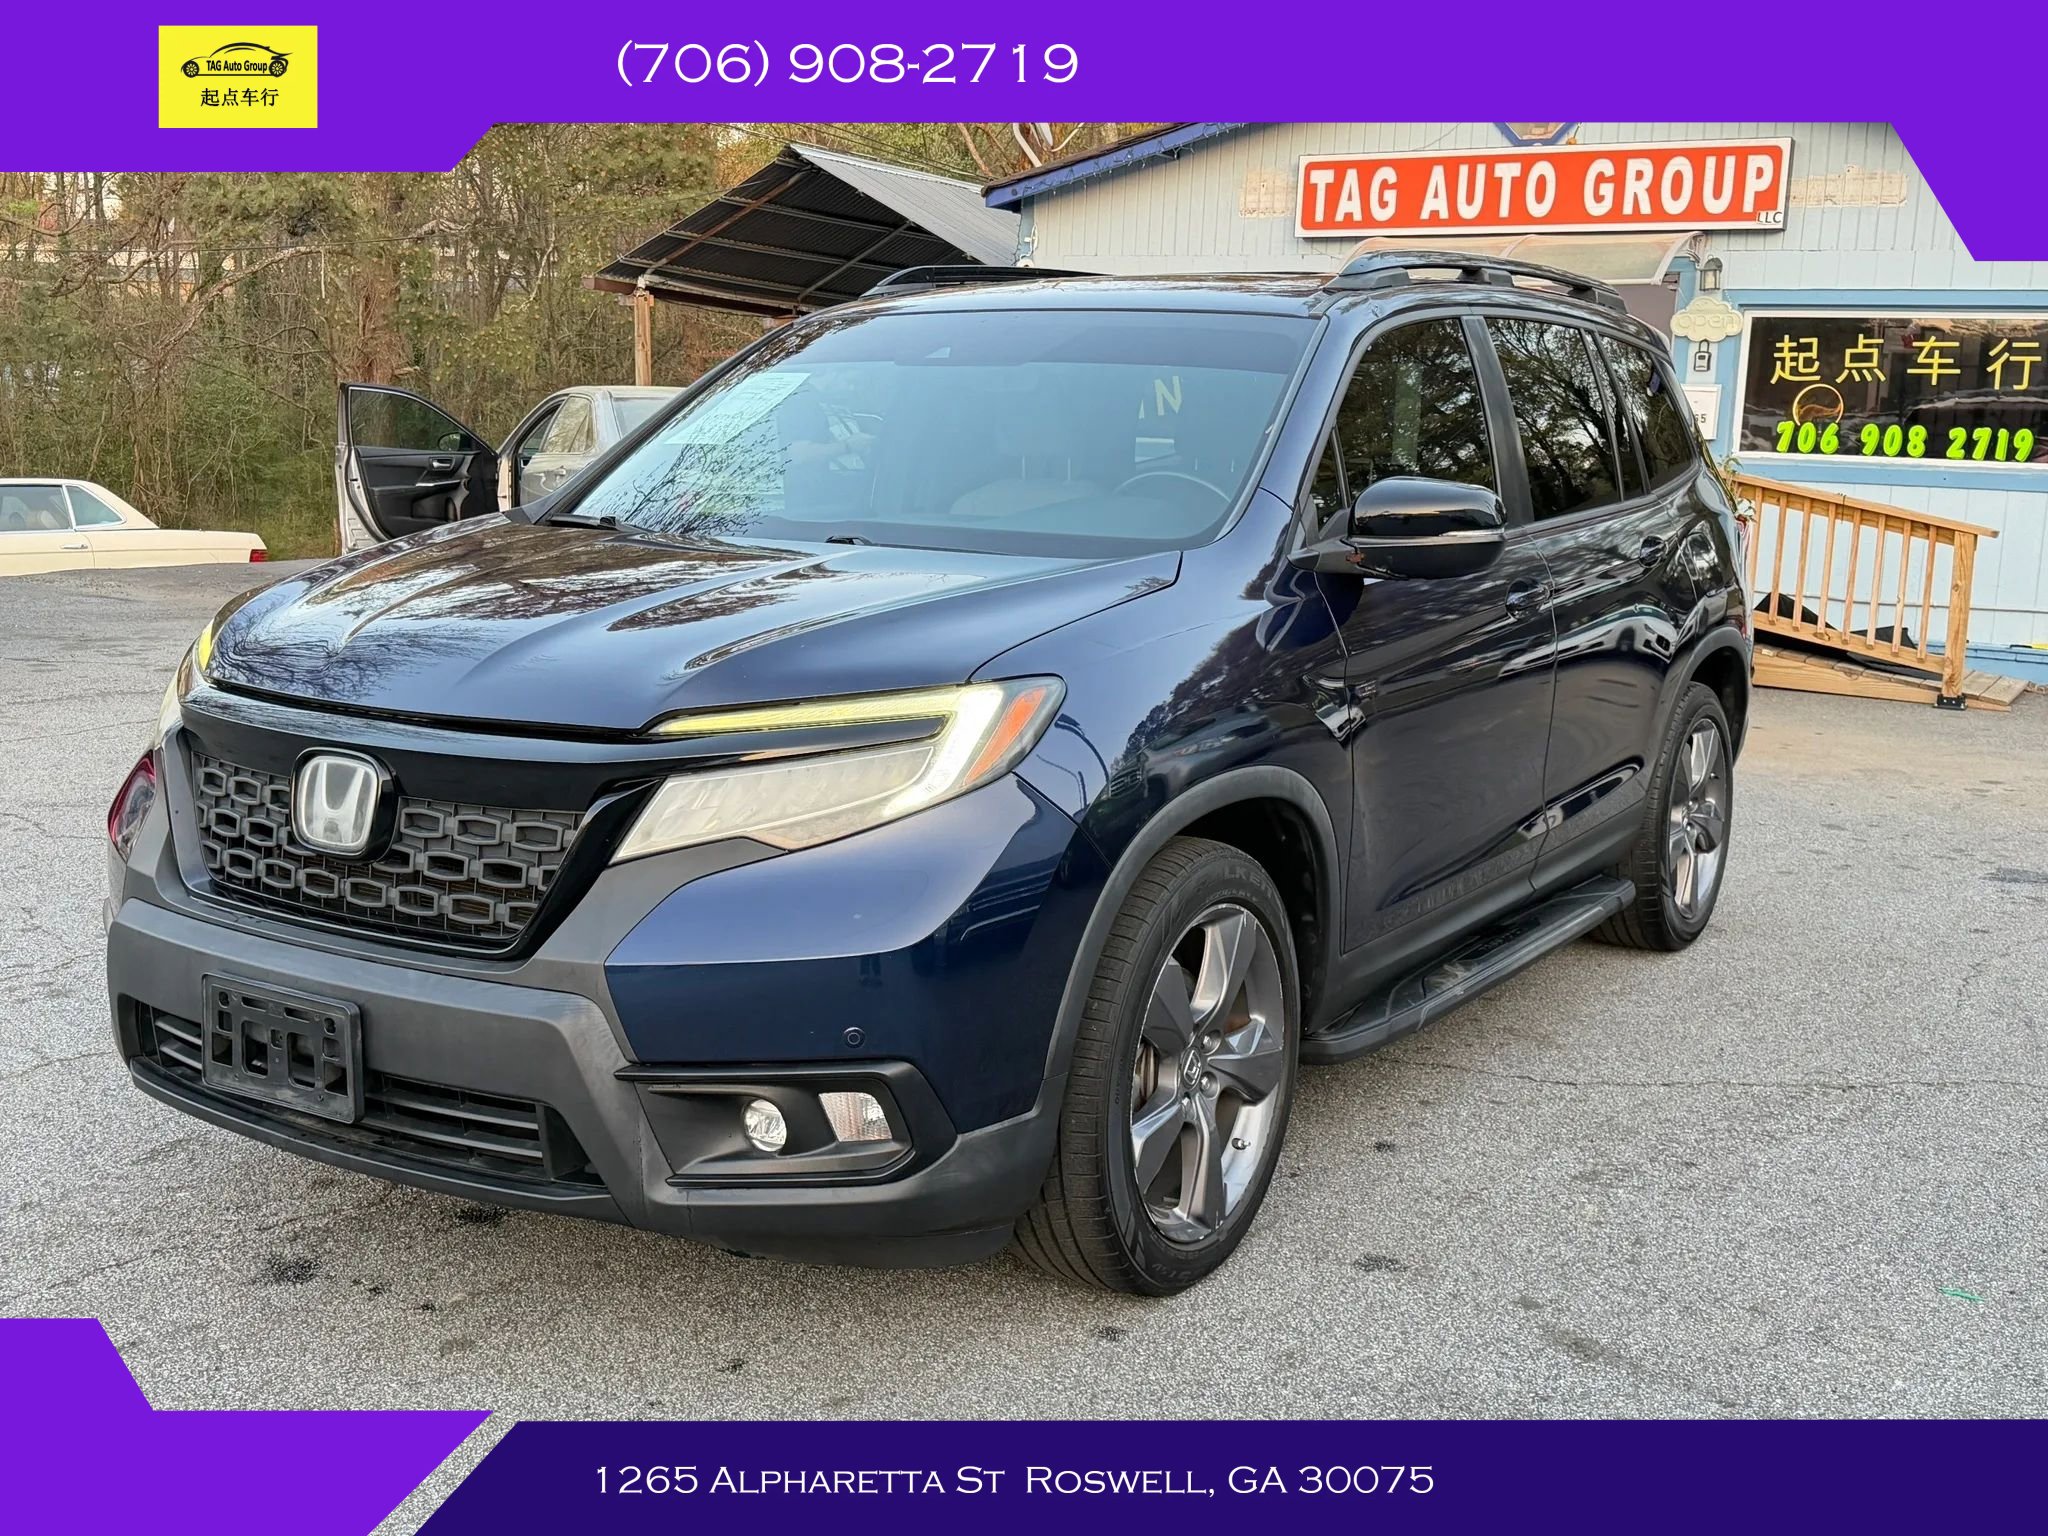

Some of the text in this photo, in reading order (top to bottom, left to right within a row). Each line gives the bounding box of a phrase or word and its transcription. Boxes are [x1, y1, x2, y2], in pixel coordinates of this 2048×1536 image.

[1308, 154, 1775, 223] TAG AUTO GROUP
[1757, 211, 1783, 224] LLC
[1678, 313, 1736, 333] open
[1770, 333, 2042, 391] 起点车行
[1776, 420, 2034, 462] 706 908 2719
